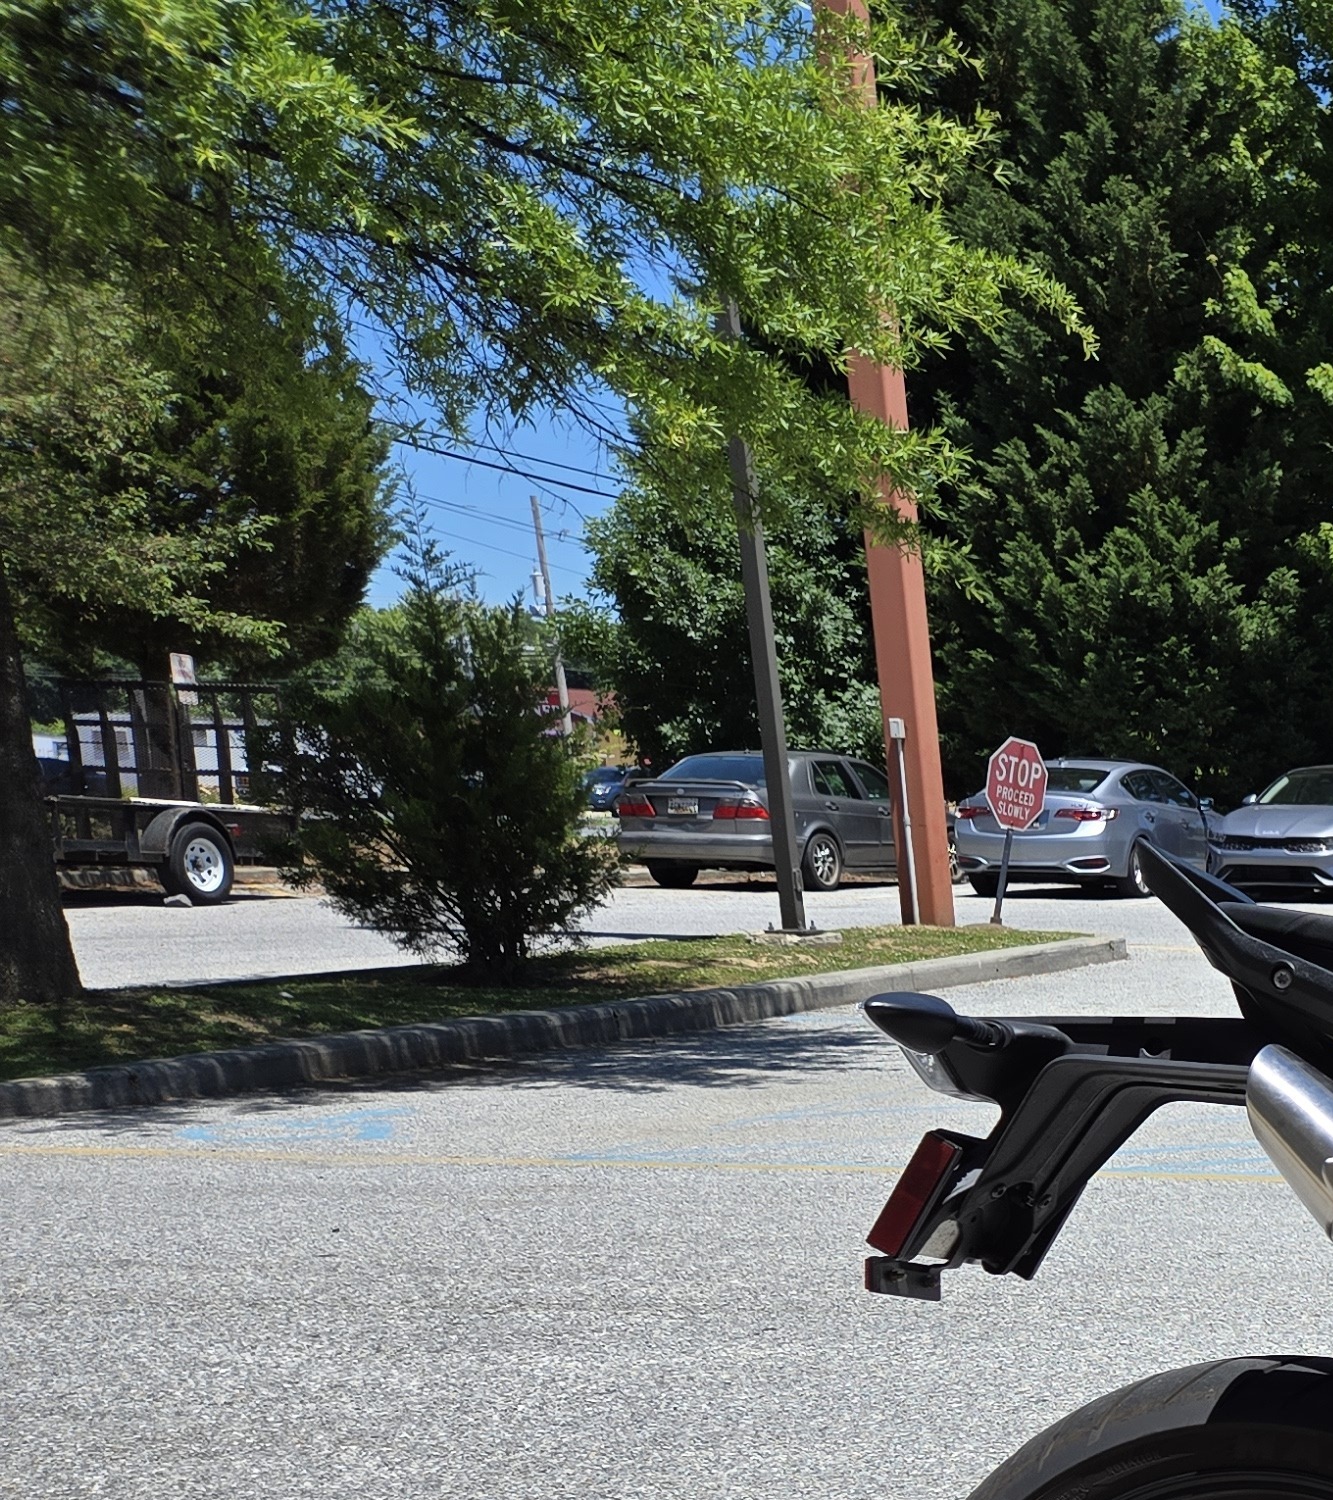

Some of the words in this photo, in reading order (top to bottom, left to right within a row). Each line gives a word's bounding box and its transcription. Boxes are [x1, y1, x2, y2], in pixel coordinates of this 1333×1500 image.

[996, 753, 1042, 789] STOP
[996, 784, 1035, 807] PROCEED
[997, 800, 1031, 821] SLOWLY
